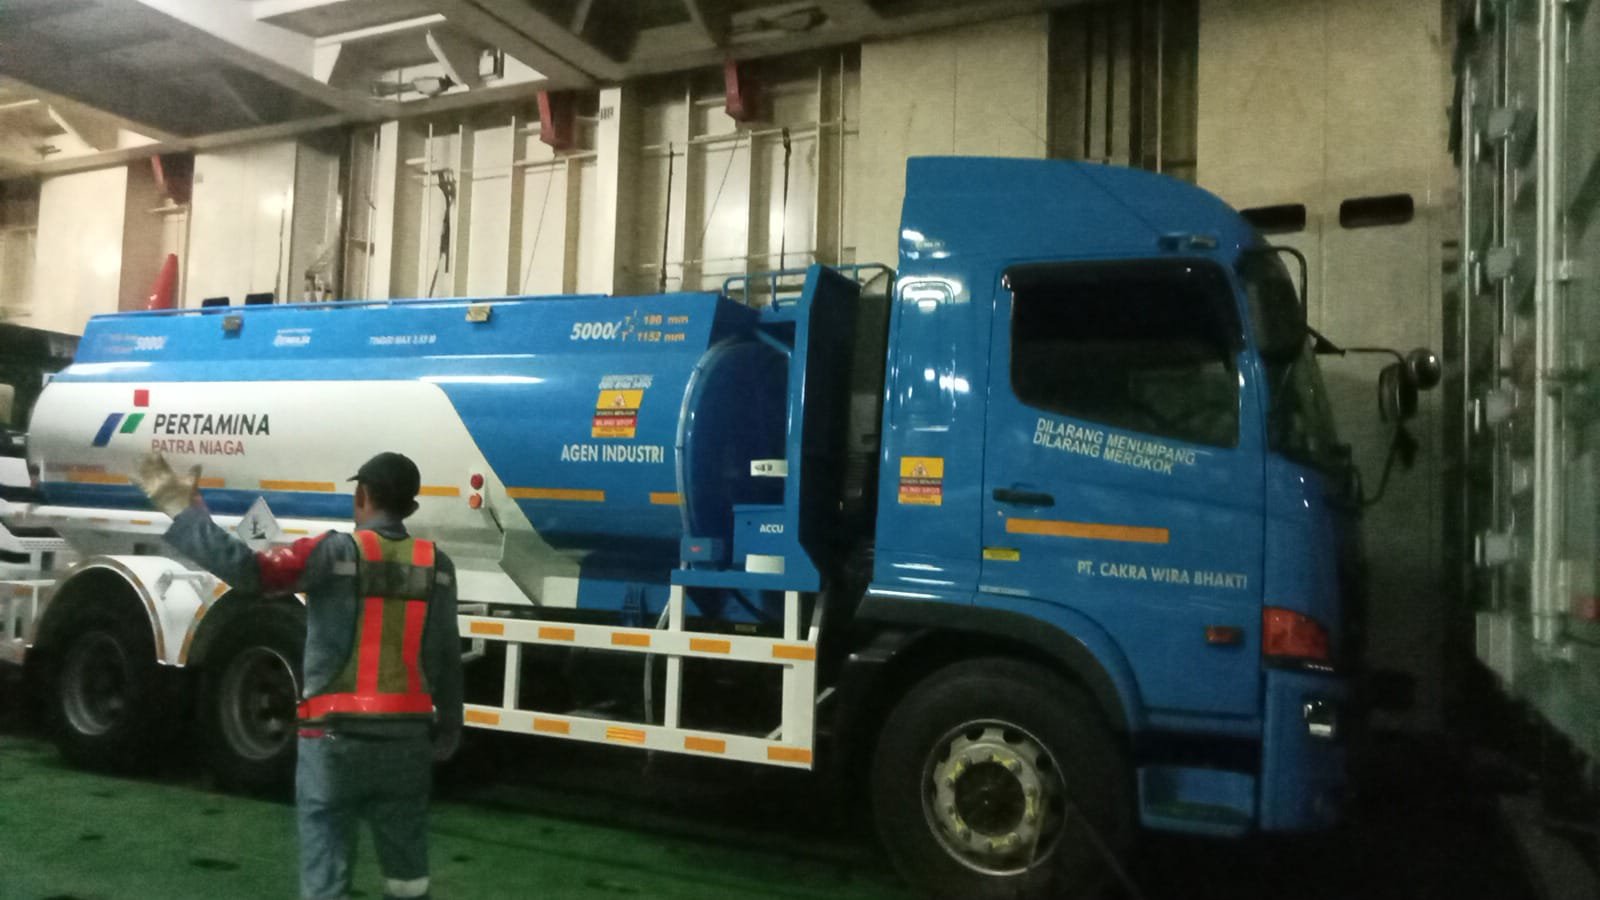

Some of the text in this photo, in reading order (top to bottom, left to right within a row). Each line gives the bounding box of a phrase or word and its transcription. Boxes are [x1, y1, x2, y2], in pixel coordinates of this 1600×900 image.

[153, 413, 270, 436] PERTAMINA
[151, 439, 246, 456] PATRA NIAGA
[1032, 431, 1174, 475] DILARANG MEROKOK
[1036, 417, 1197, 466] DILARANG MENUMPANG
[560, 443, 665, 464] AGEN INDUSTRI
[759, 523, 785, 534] ACCU
[1077, 559, 1248, 590] PT. CAKRA WIRA BHAKTI
